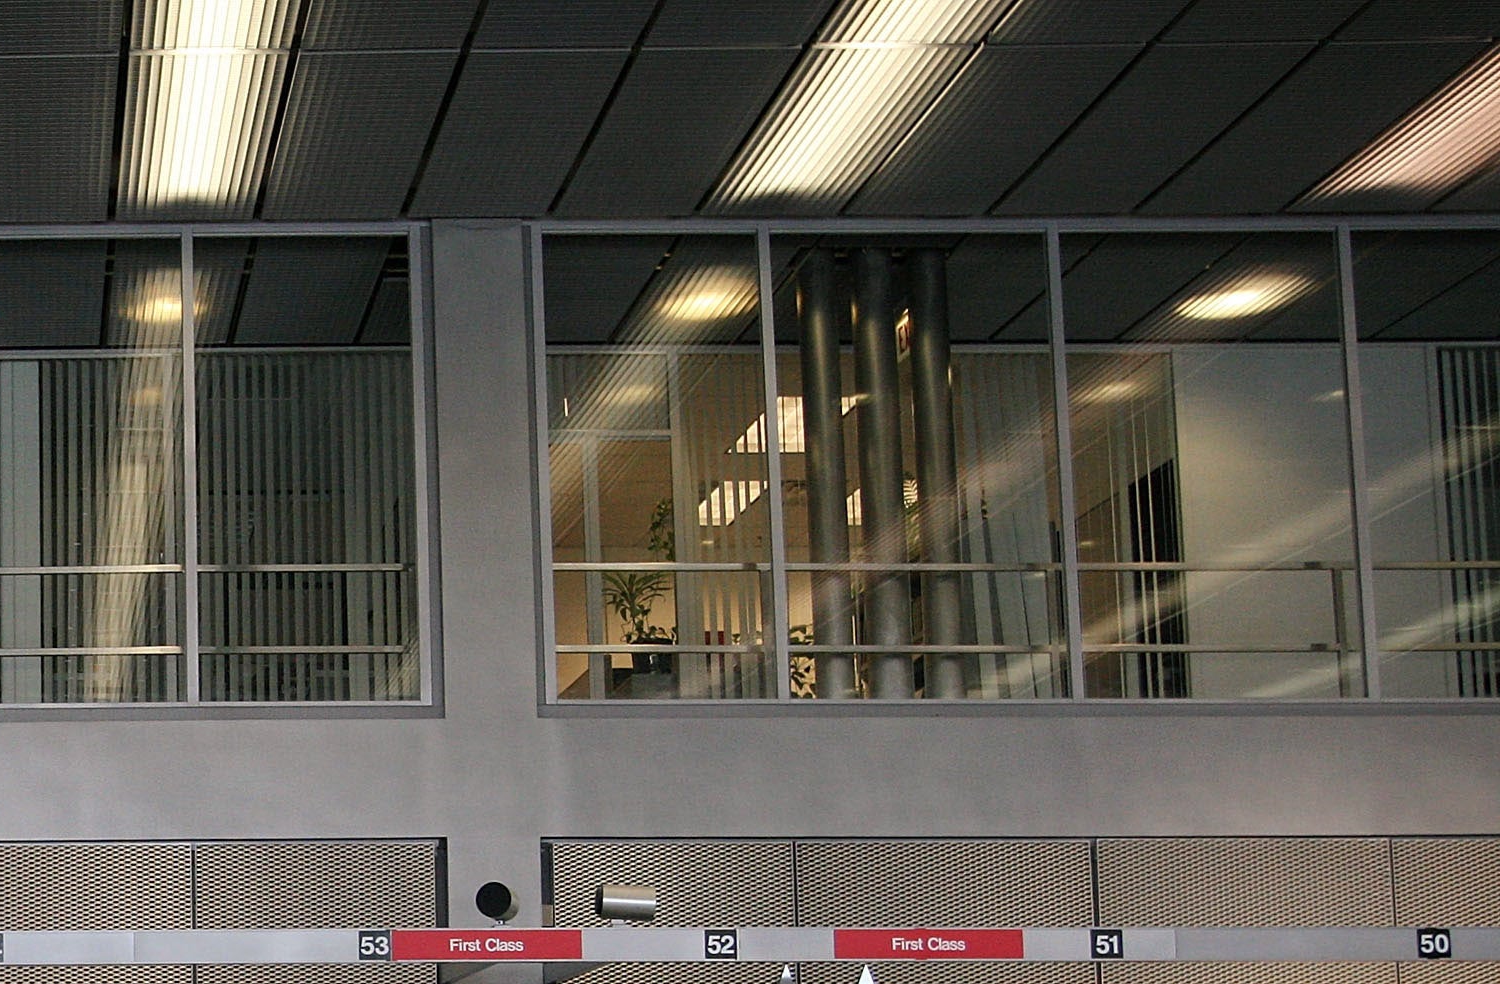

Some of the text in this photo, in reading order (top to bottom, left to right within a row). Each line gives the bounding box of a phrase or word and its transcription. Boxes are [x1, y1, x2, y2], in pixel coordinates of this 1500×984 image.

[360, 936, 390, 955] 53
[449, 938, 524, 952] First Class
[706, 935, 736, 955] 52
[891, 937, 966, 951] First Class
[1094, 935, 1120, 954] 51
[1420, 934, 1449, 954] 50
